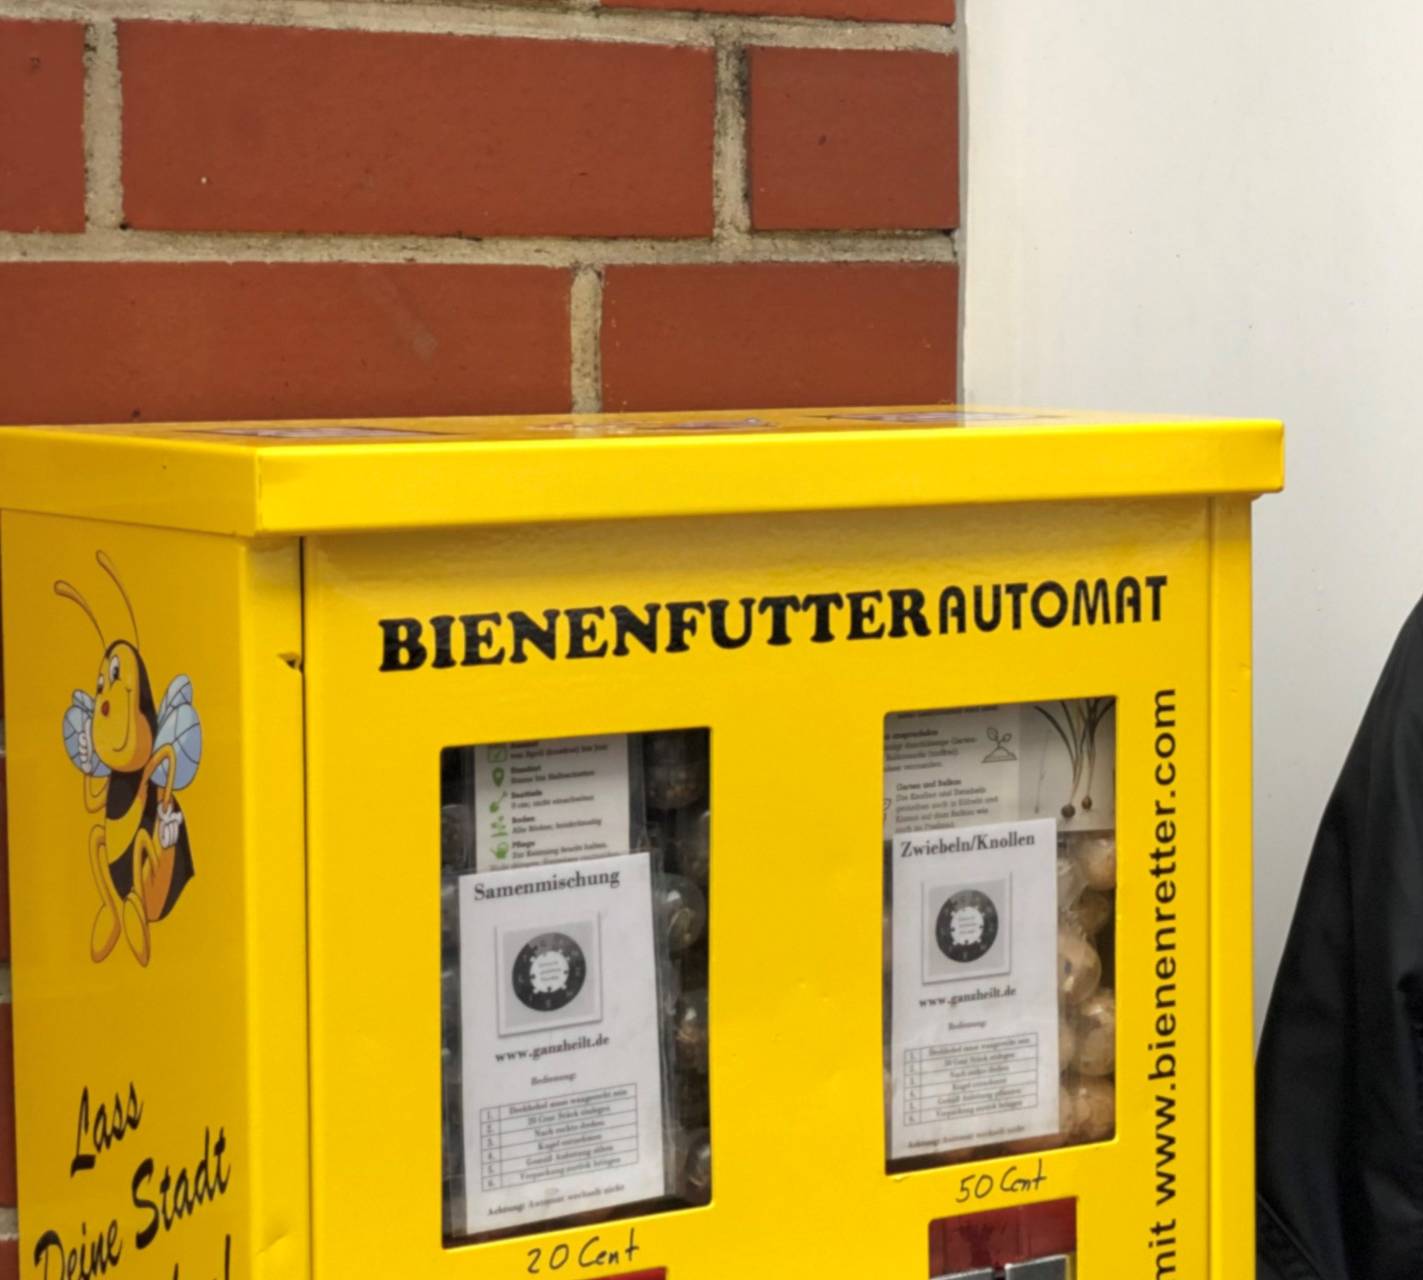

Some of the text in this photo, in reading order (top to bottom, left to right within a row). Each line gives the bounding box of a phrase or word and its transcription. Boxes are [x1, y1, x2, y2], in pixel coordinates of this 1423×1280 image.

[900, 831, 1035, 858] Zwiebeln/Knollen
[474, 870, 620, 901] Samenmischung
[1148, 688, 1177, 1206] www.bienenretter.com
[918, 985, 1017, 1008] www.ganzheilt.de
[495, 1034, 610, 1063] www.ganzheilt.de
[70, 1081, 144, 1178] Lass
[34, 1219, 123, 1280] Deine
[131, 1126, 231, 1249] Stadt
[956, 1158, 1047, 1203] 50 Cent
[527, 1227, 640, 1274] 20 Cent
